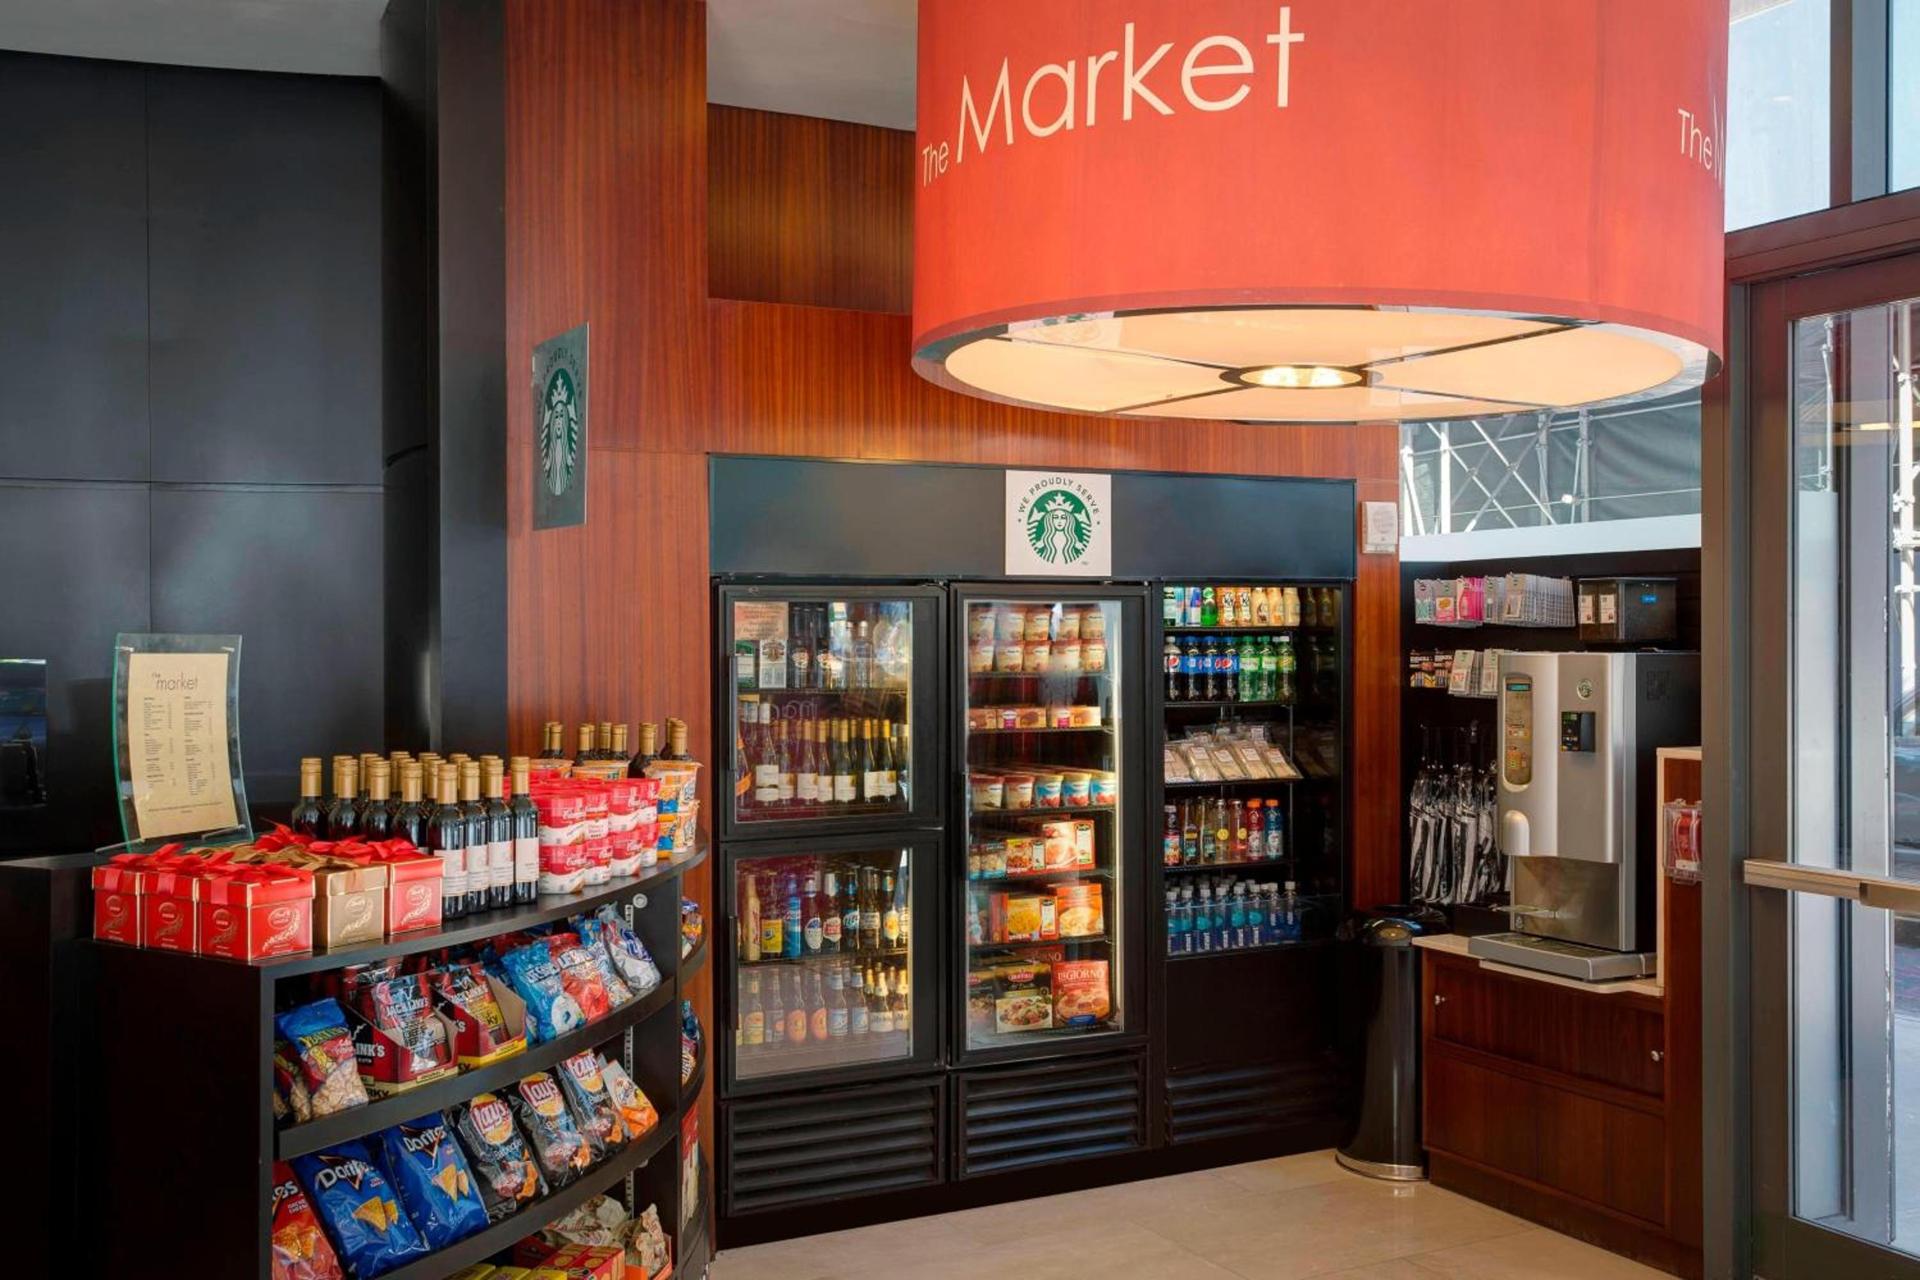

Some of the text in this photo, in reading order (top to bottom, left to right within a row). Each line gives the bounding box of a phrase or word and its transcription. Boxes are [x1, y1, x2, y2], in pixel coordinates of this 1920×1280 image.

[921, 5, 1306, 188] The Market
[1678, 107, 1713, 171] The
[1018, 476, 1100, 514] WE PROUDLY SERVE
[156, 672, 199, 691] market
[354, 1042, 386, 1058] INK'S
[402, 1124, 448, 1152] Doritos
[317, 1159, 375, 1189] Dorito
